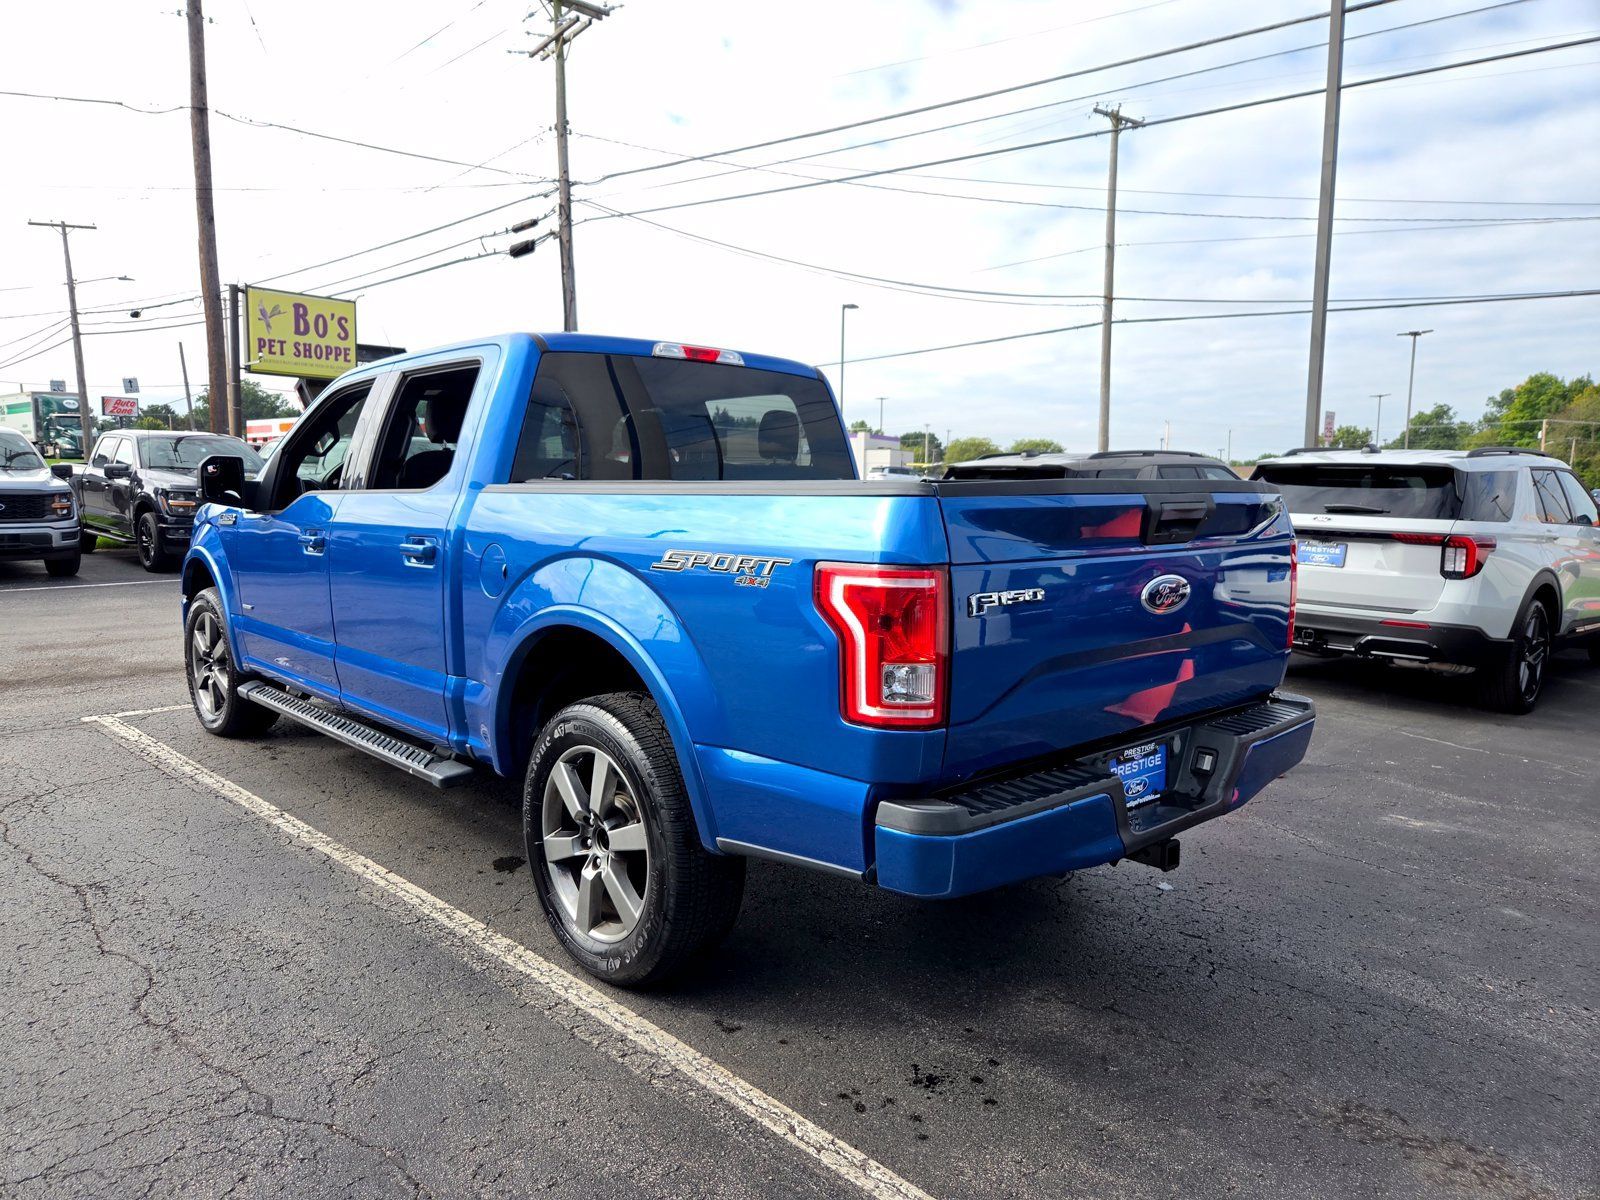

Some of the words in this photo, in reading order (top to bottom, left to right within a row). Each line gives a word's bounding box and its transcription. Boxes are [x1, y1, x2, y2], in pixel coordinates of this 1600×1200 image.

[257, 337, 287, 356] PET
[293, 341, 352, 363] SHOPPE
[109, 407, 133, 415] Zone
[113, 399, 137, 408] Auto
[1300, 545, 1341, 554] PRESTIGE
[650, 549, 793, 577] SPORT
[1123, 742, 1156, 758] PRESTIGE
[1128, 779, 1146, 795] Ford
